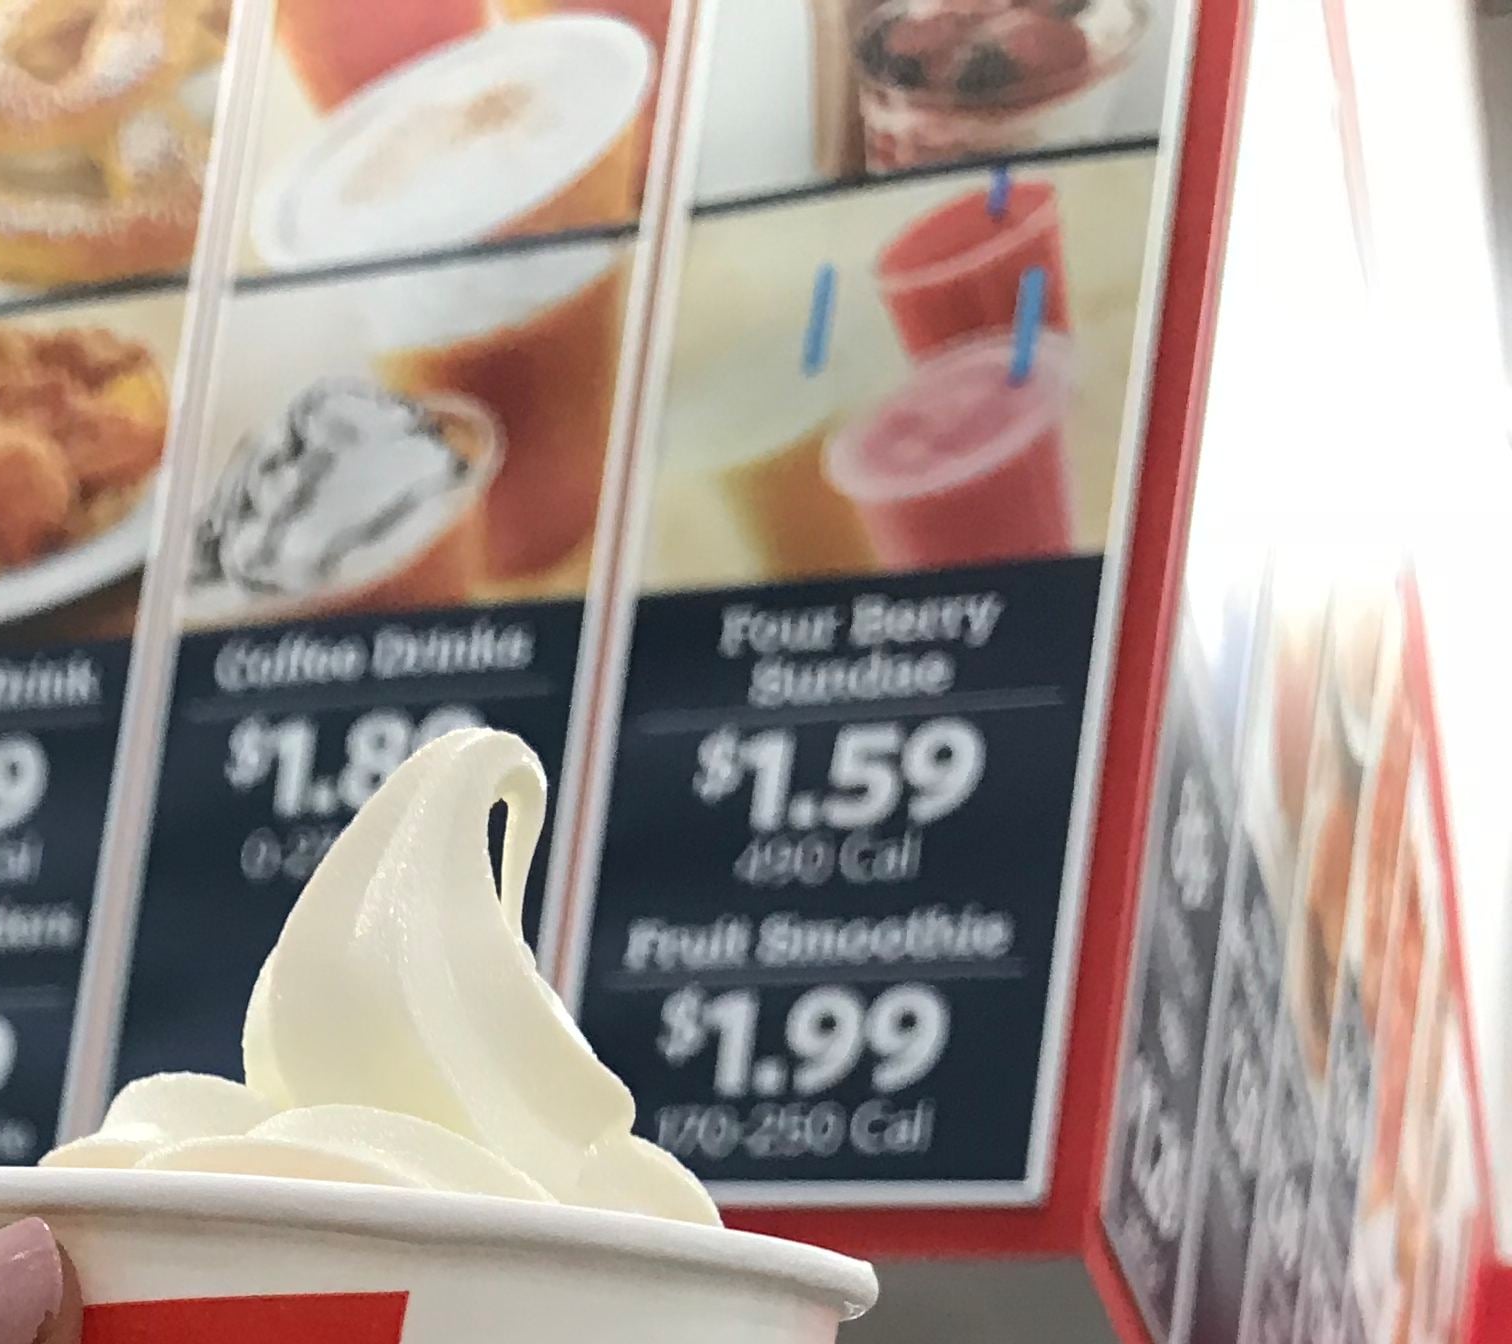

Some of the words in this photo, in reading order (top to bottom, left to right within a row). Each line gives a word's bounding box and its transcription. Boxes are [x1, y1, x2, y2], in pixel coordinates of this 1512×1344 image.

[848, 592, 1006, 647] Berry
[693, 716, 988, 833] $1.59
[755, 905, 1014, 965] Smoothie
[657, 982, 951, 1098] $1.99
[849, 1100, 936, 1155] Cal
